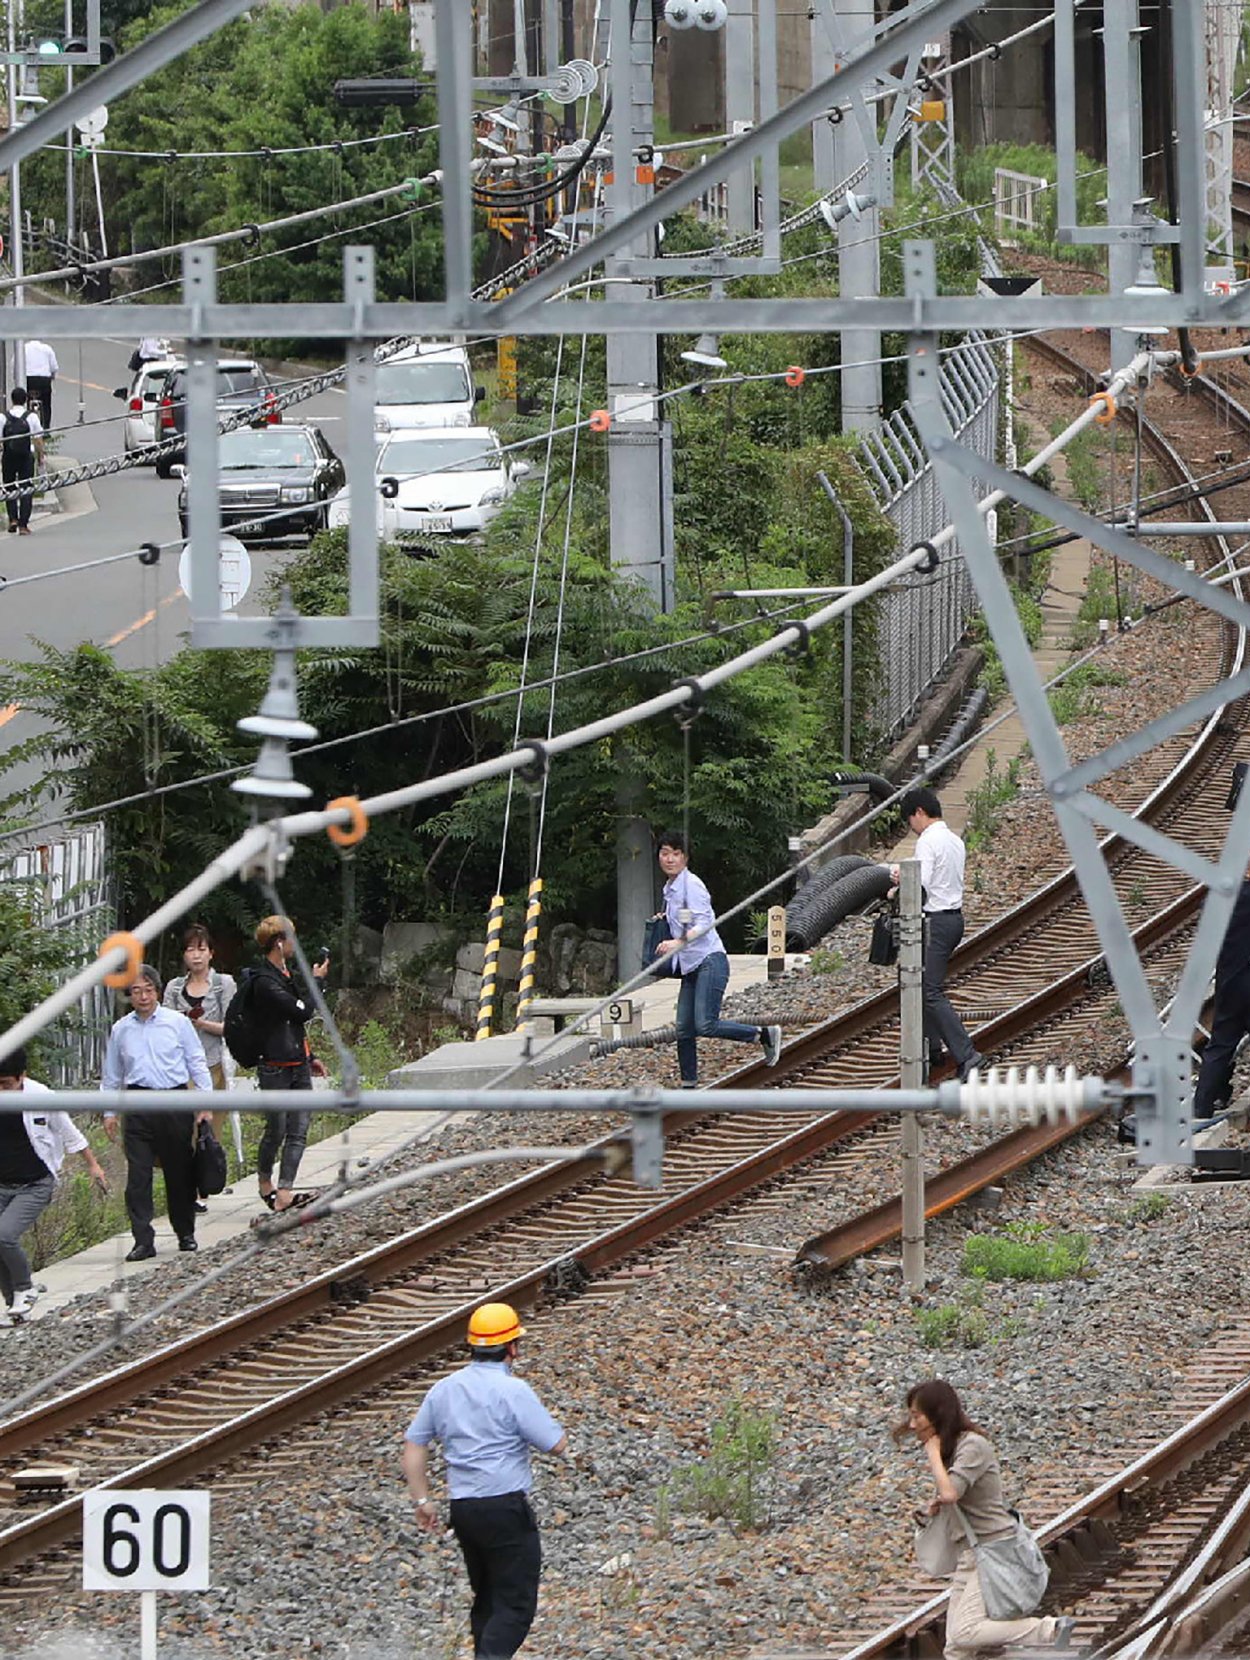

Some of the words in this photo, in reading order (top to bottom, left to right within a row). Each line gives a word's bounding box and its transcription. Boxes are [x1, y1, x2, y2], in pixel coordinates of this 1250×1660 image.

[771, 914, 782, 953] 550
[609, 1004, 622, 1021] 9
[103, 1503, 191, 1577] 60
